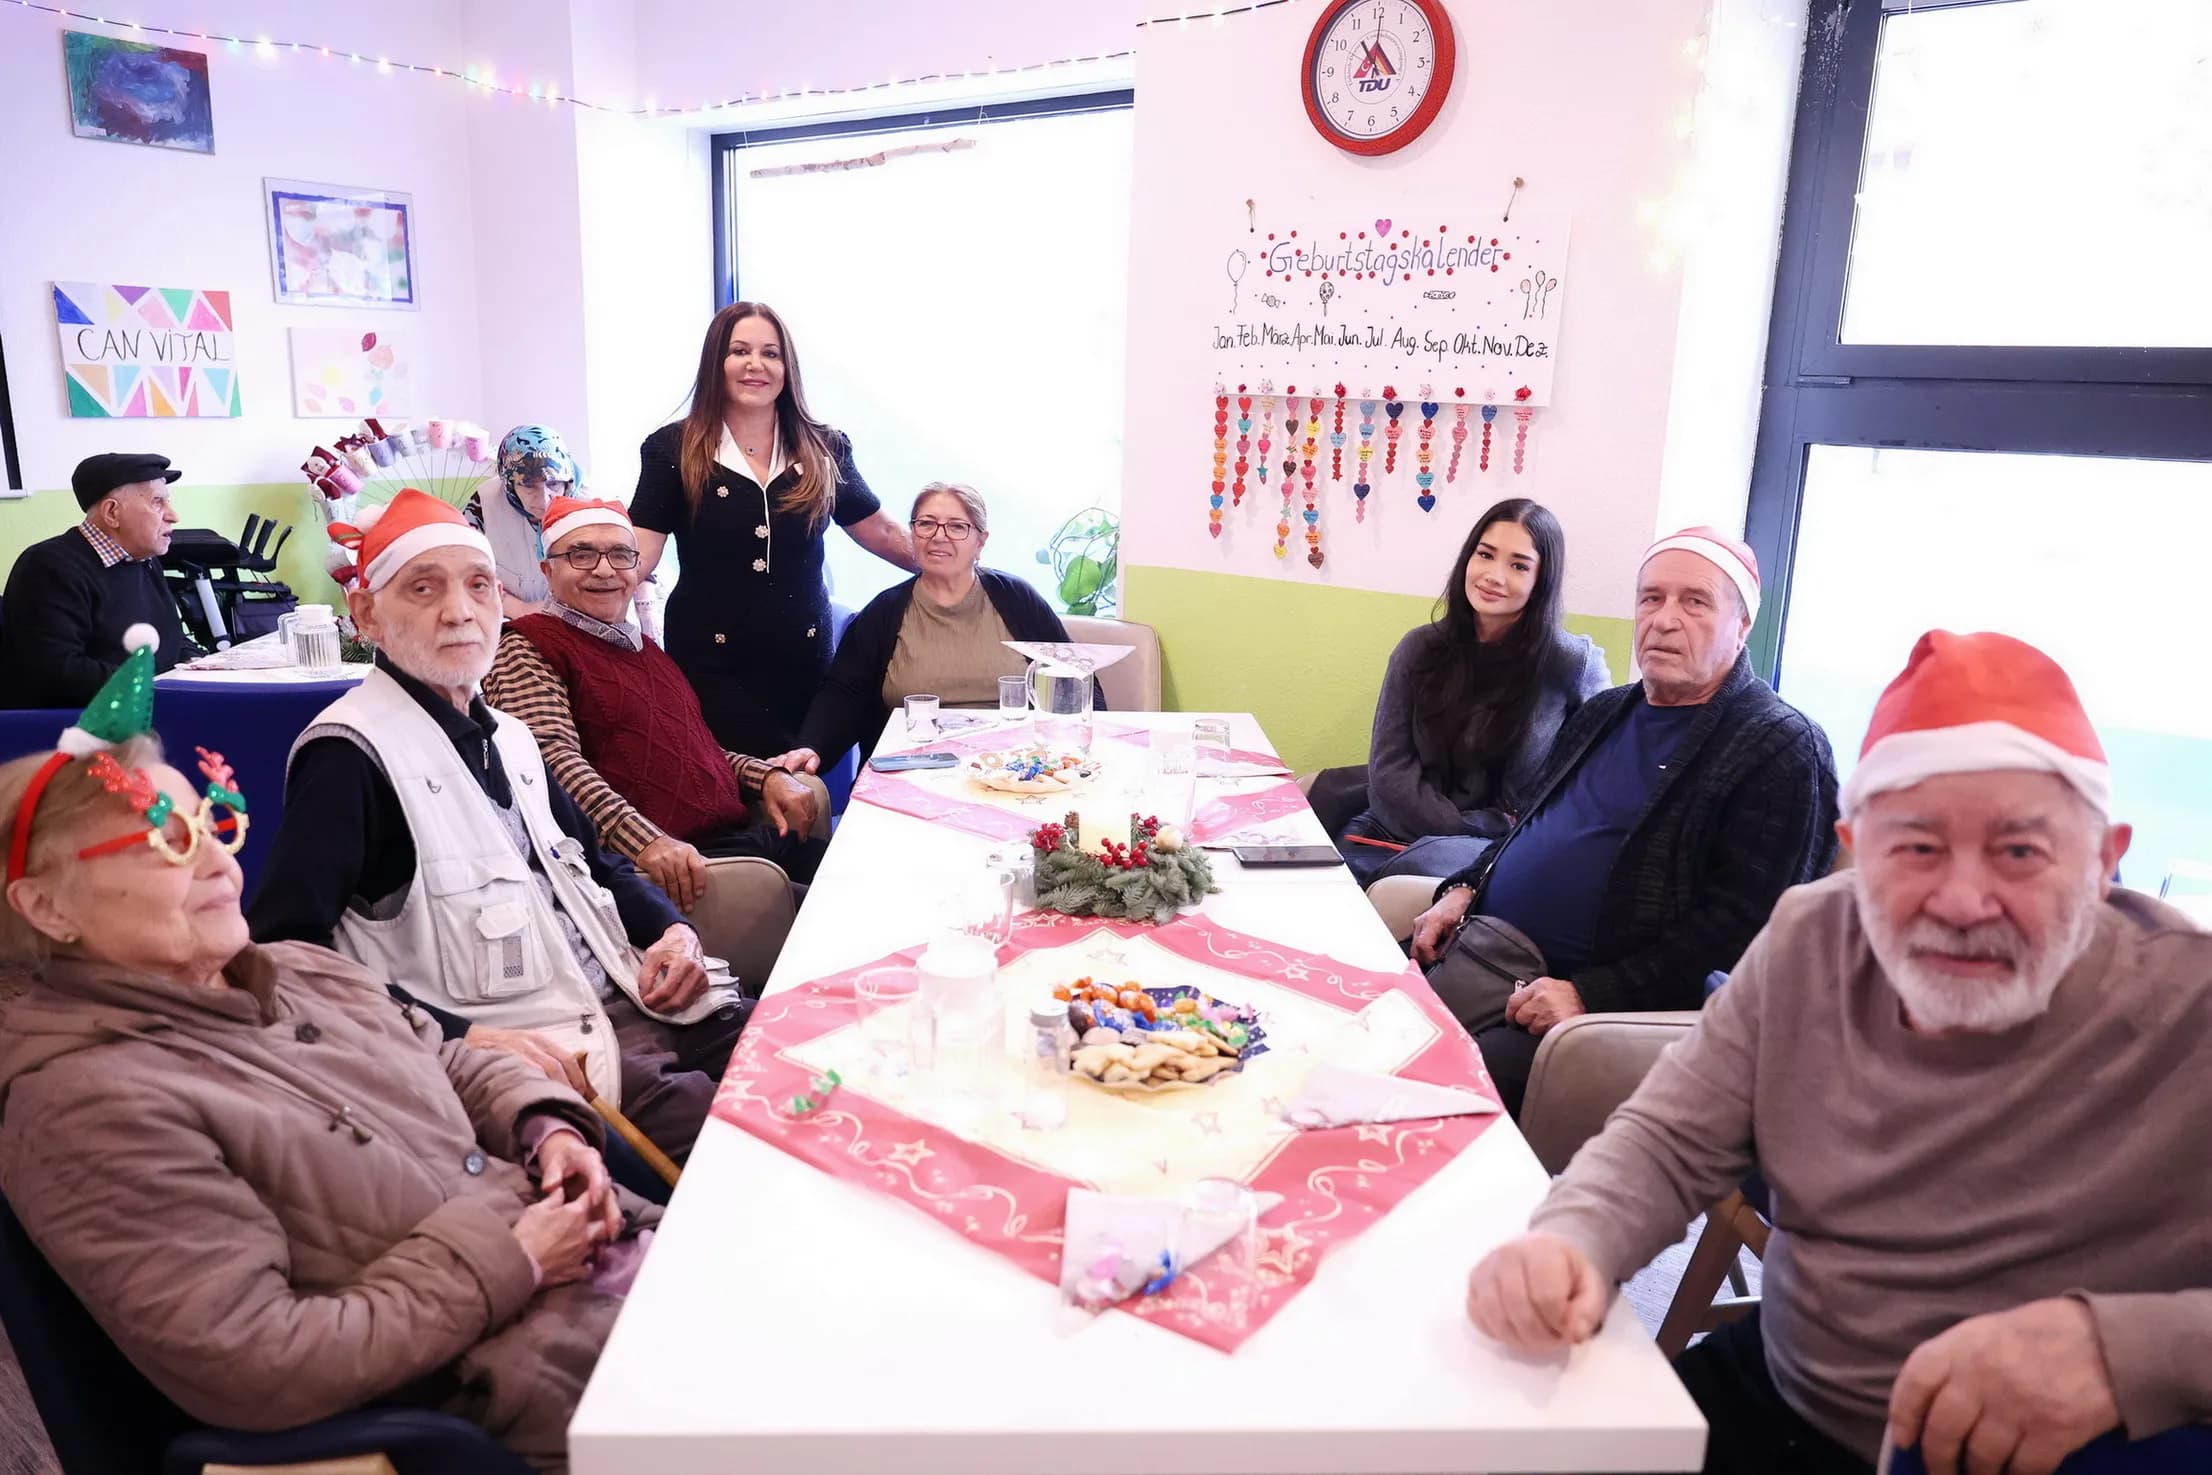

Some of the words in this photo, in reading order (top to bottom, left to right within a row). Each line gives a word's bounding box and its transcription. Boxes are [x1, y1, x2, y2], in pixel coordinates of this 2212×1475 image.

[1373, 7, 1385, 20] 12
[1399, 13, 1404, 25] 1
[1352, 19, 1362, 30] 11
[1412, 31, 1420, 43] 2
[1335, 39, 1347, 51] 10
[1417, 57, 1425, 68] 3
[1327, 66, 1334, 77] 9
[1359, 78, 1391, 92] TDU
[1331, 92, 1339, 103] 8
[1408, 86, 1415, 97] 4
[1347, 110, 1354, 121] 7
[1390, 106, 1398, 118] 5
[1367, 116, 1375, 126] 6
[1269, 235, 1504, 287] Geburtstagskalender
[77, 328, 141, 362] CAN
[1212, 326, 1236, 349] Jan.
[1236, 324, 1260, 347] Feb.
[1338, 324, 1362, 347] Jun.
[1391, 326, 1420, 356] Aug.
[1453, 332, 1480, 355] Okt.
[1482, 335, 1513, 357] Nov.
[1515, 334, 1549, 358] Dez.
